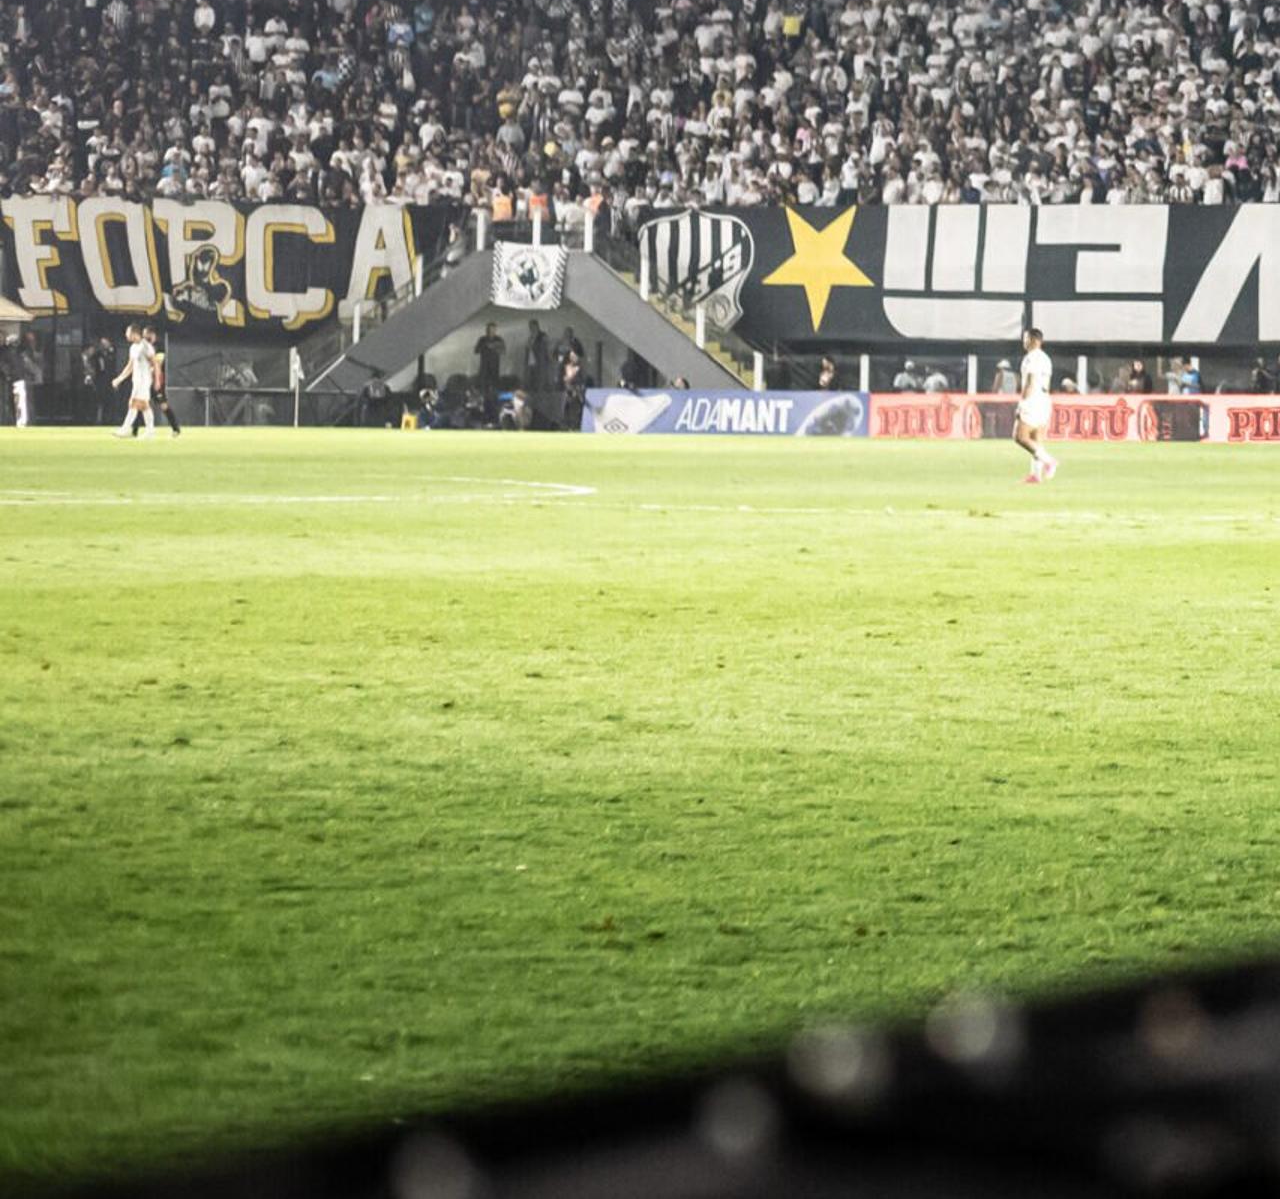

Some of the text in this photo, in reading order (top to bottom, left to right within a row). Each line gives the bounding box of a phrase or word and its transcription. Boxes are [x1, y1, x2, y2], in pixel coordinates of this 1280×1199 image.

[4, 195, 424, 331] FORÇA
[675, 398, 793, 433] ADAMANT
[1047, 398, 1134, 441] PITÚ
